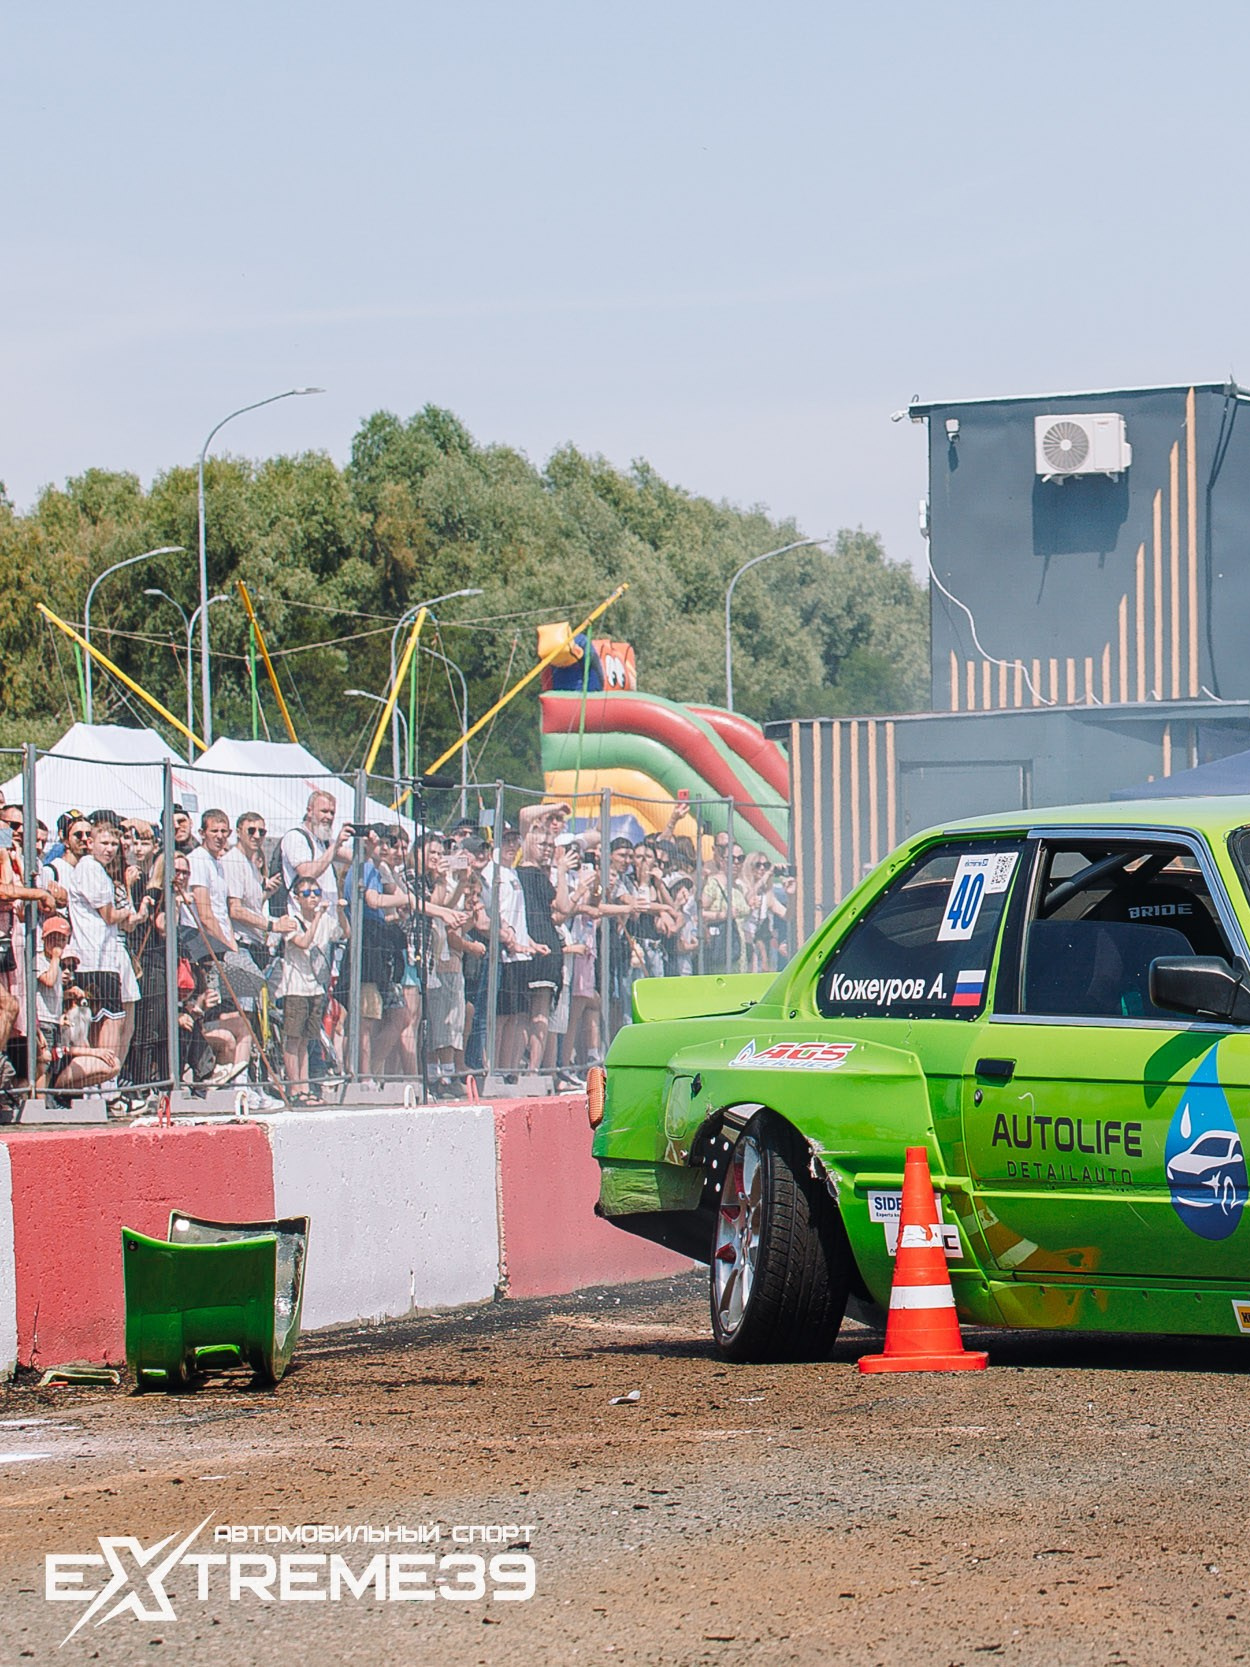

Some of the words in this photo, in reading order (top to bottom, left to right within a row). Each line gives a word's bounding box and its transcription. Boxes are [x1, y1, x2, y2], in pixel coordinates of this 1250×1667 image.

[947, 873, 984, 929] 40
[1128, 903, 1193, 918] BRIDE
[829, 973, 926, 1006] Кожеуров
[926, 972, 948, 999] А.
[992, 1113, 1142, 1158] AUTOLIFE
[1007, 1160, 1133, 1185] DETAILAUTO
